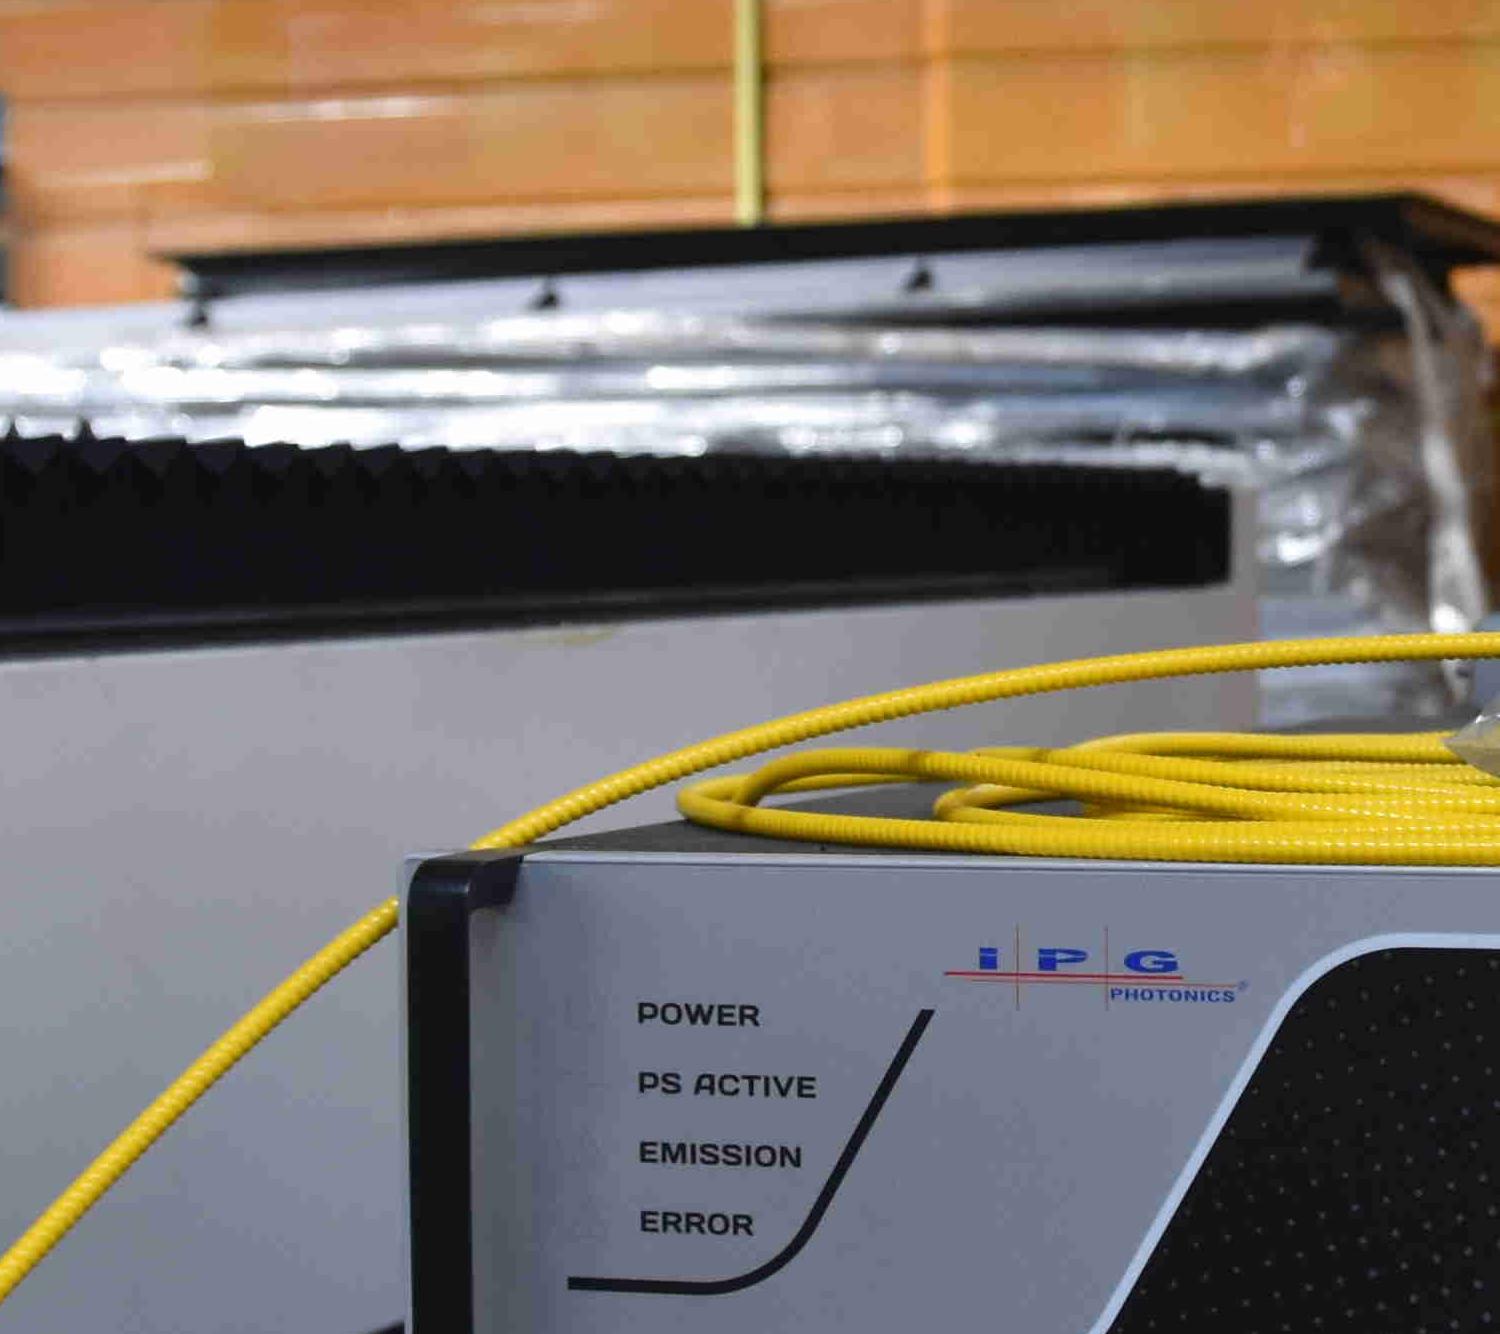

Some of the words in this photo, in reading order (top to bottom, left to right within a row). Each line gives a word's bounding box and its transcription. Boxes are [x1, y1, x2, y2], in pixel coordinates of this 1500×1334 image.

[1110, 988, 1235, 1003] PHOTONICS
[637, 1002, 760, 1027] POWER
[638, 1071, 682, 1095] PS
[693, 1073, 817, 1099] ACTIVE
[639, 1141, 801, 1168] EMISSION
[640, 1210, 754, 1237] ERROR
